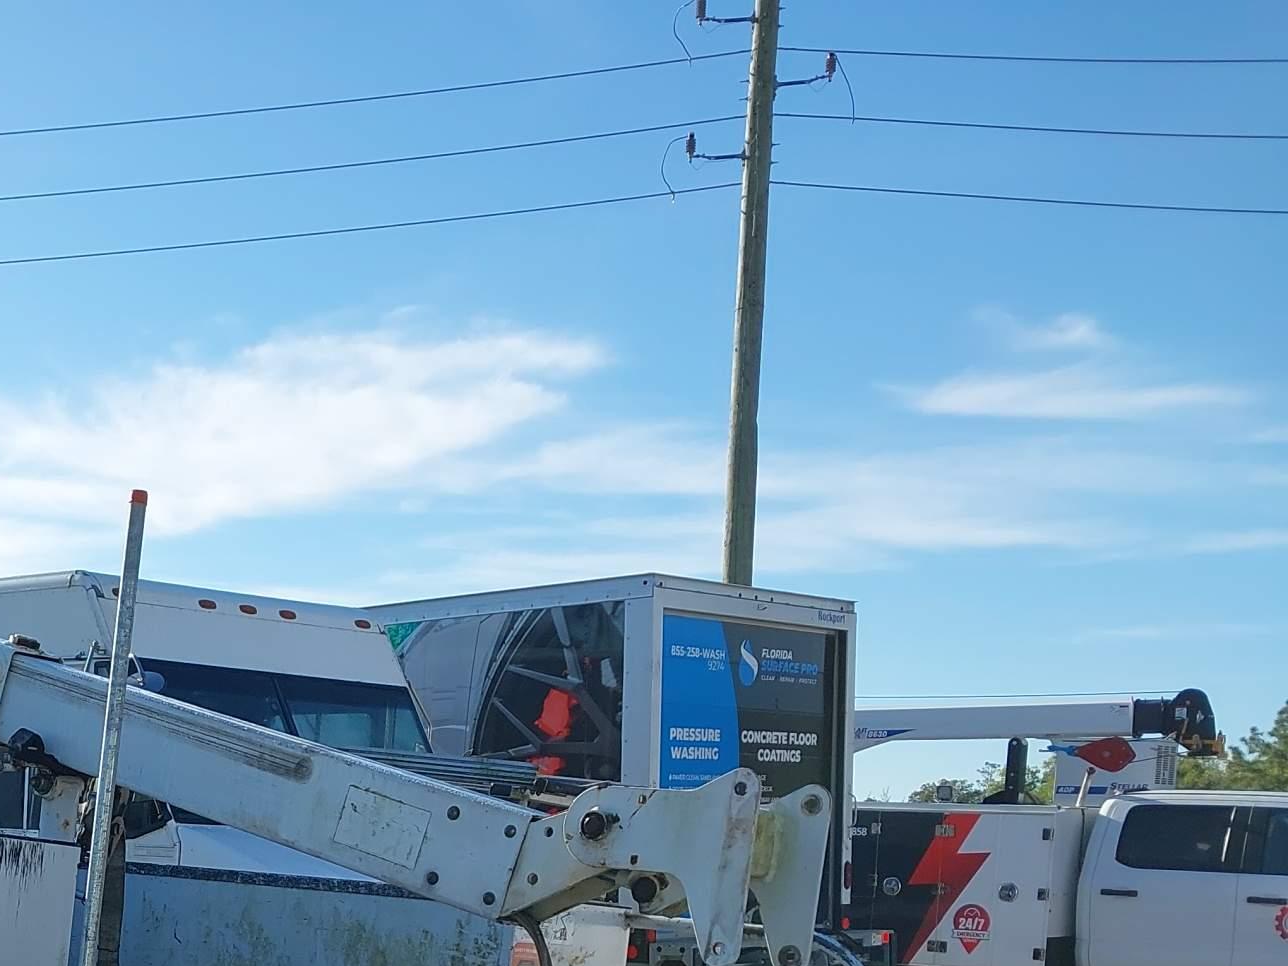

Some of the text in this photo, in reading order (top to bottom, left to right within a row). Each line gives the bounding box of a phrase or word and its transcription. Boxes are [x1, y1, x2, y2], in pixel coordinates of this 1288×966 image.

[671, 645, 726, 660] 855-258-WASH
[761, 648, 793, 660] FLORIDA
[708, 661, 725, 671] 9274
[761, 660, 818, 676] SURFACE PRO
[669, 727, 721, 742] PRESSURE
[741, 730, 818, 746] CONCRETE FLOOR
[670, 746, 719, 760] WASHING
[757, 749, 801, 763] COATINGS
[958, 917, 985, 930] 24/7
